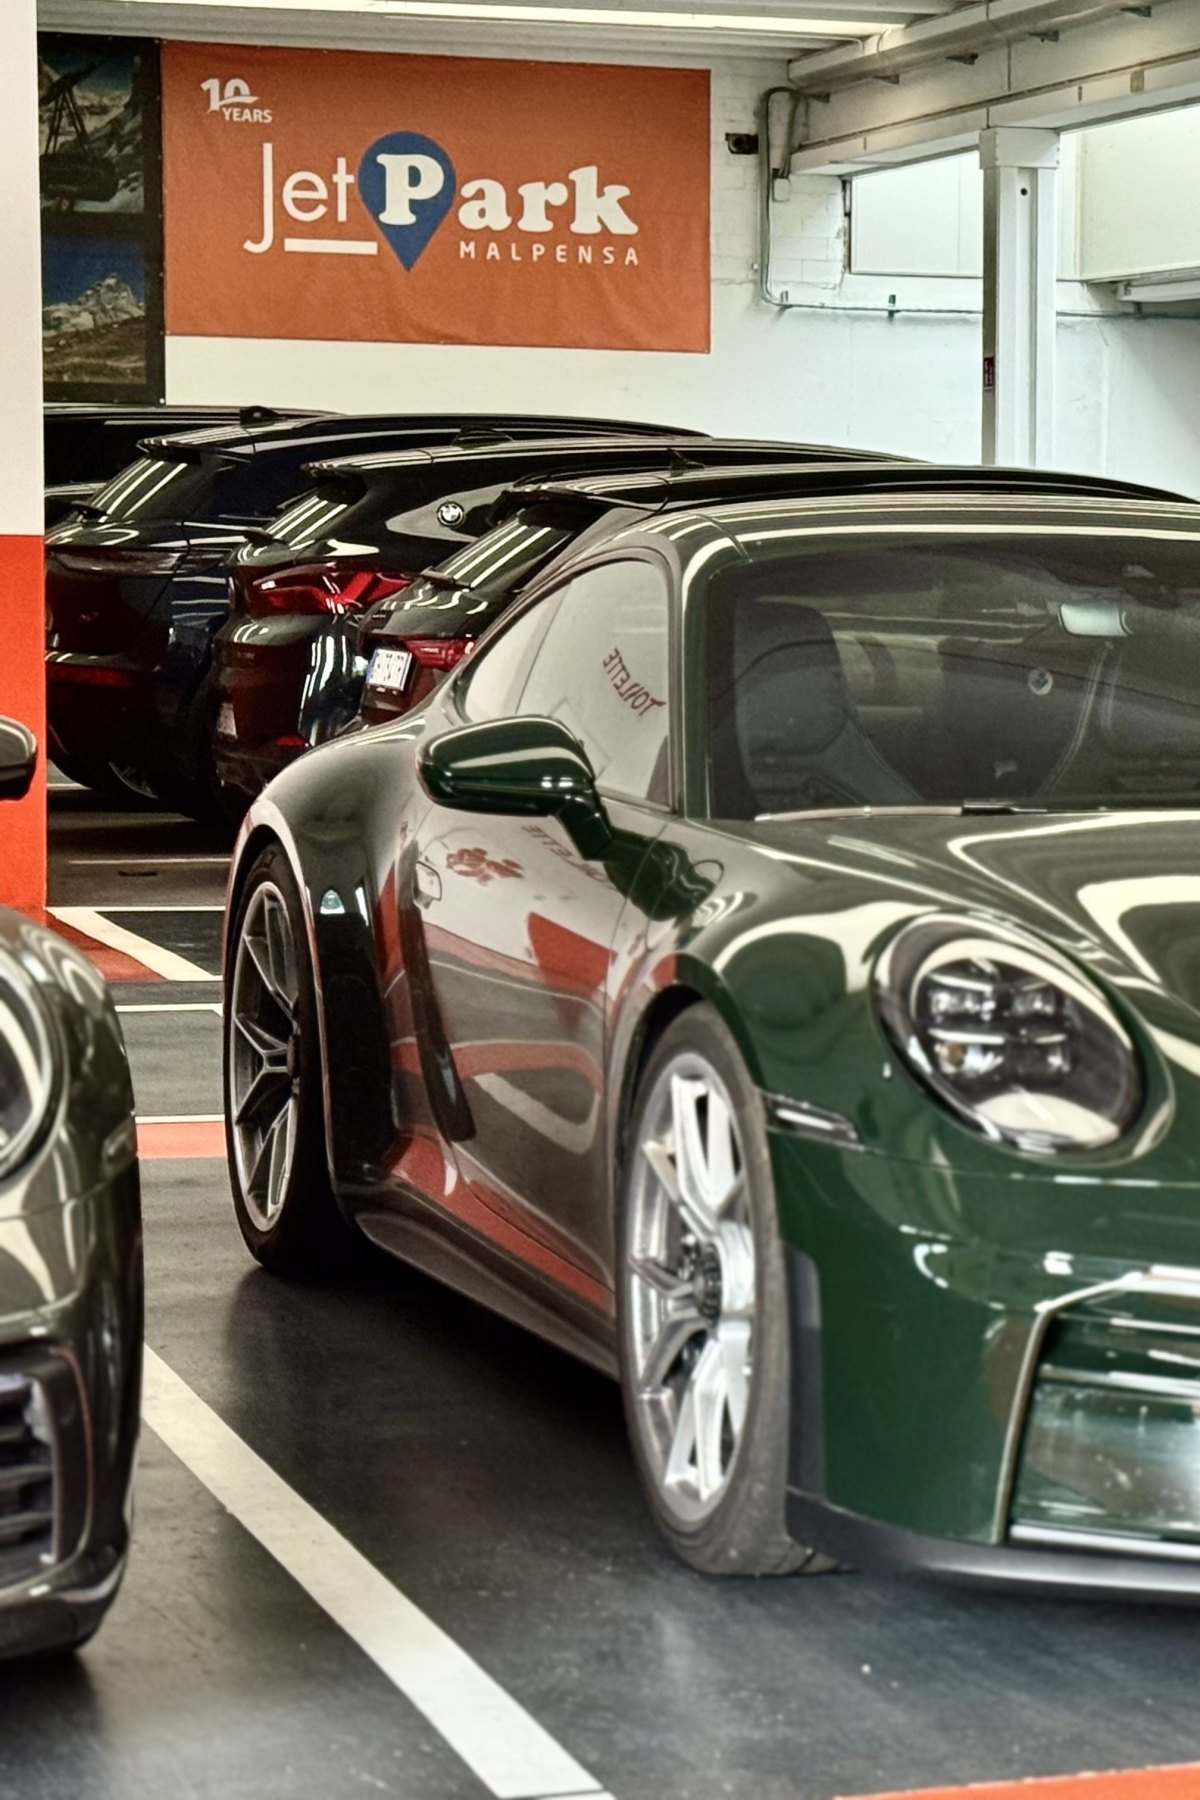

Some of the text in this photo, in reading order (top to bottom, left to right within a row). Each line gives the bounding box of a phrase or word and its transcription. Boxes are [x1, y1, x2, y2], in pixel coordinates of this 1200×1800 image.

[200, 77, 259, 113] 10
[222, 107, 273, 124] YEARS
[459, 240, 639, 266] MALPENSA
